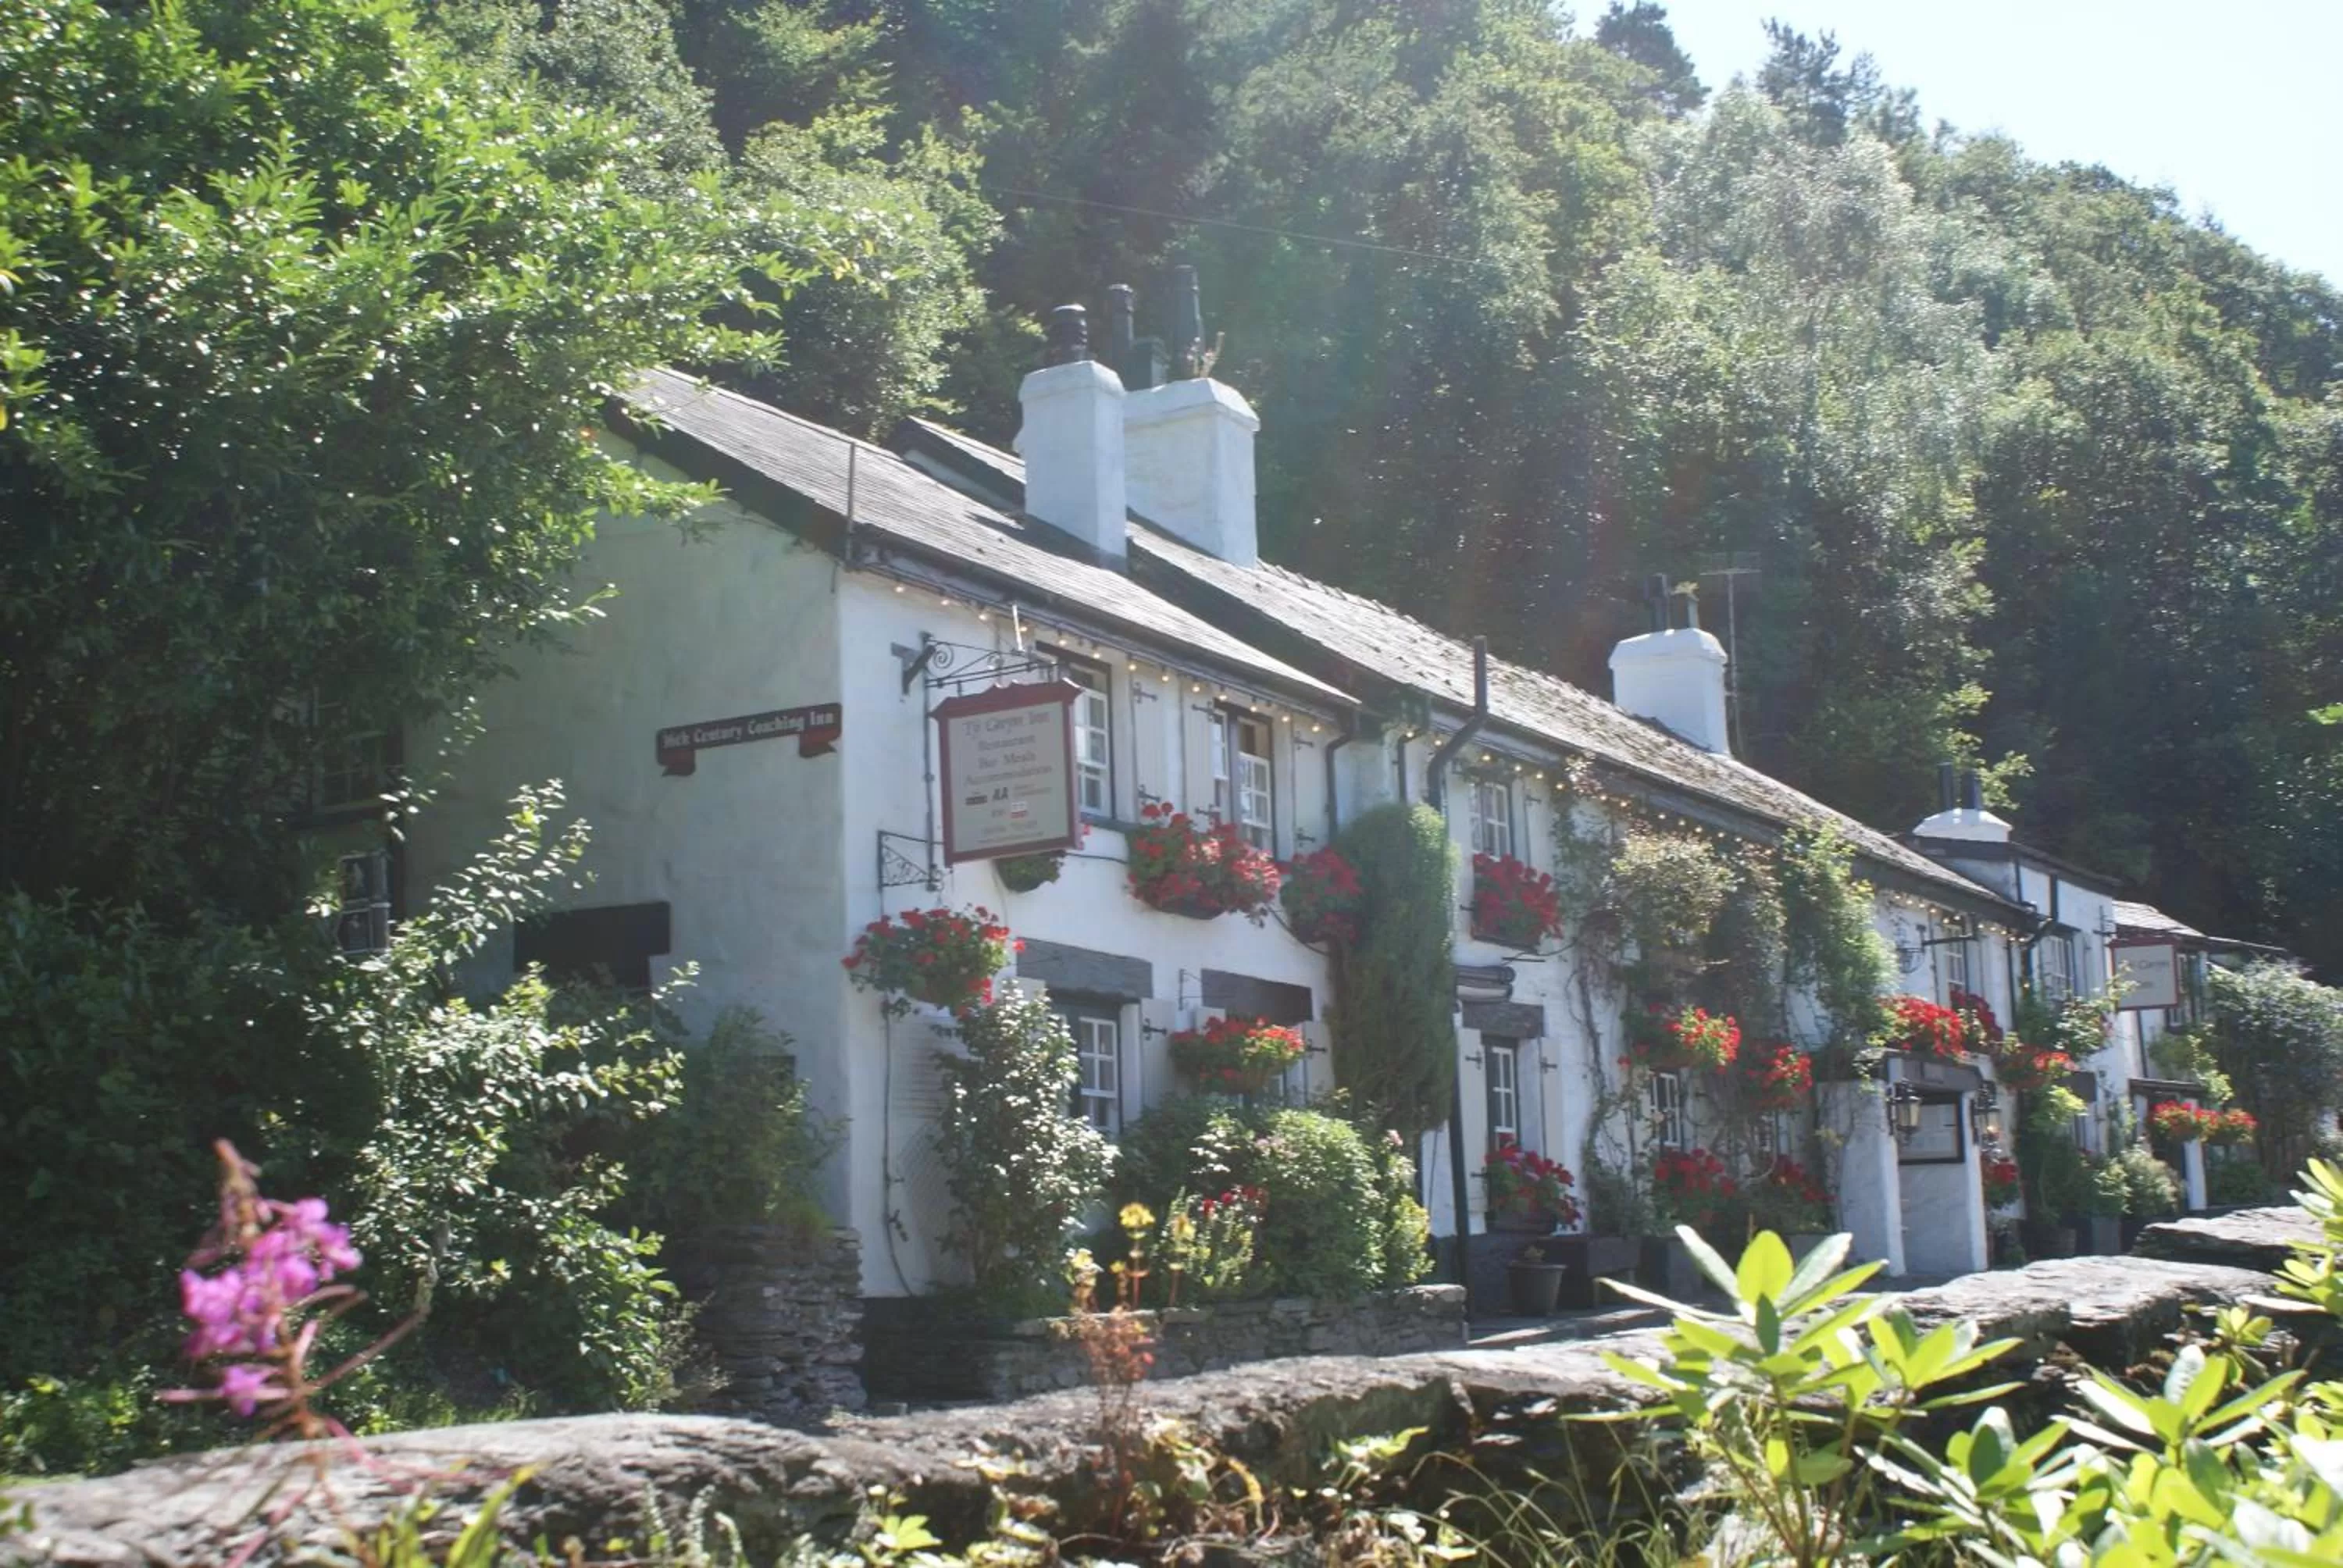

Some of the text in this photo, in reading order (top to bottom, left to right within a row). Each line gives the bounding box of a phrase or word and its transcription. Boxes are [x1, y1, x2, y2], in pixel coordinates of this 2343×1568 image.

[693, 726, 742, 743] Century
[747, 715, 804, 734] Coaching
[810, 711, 835, 725] Inn
